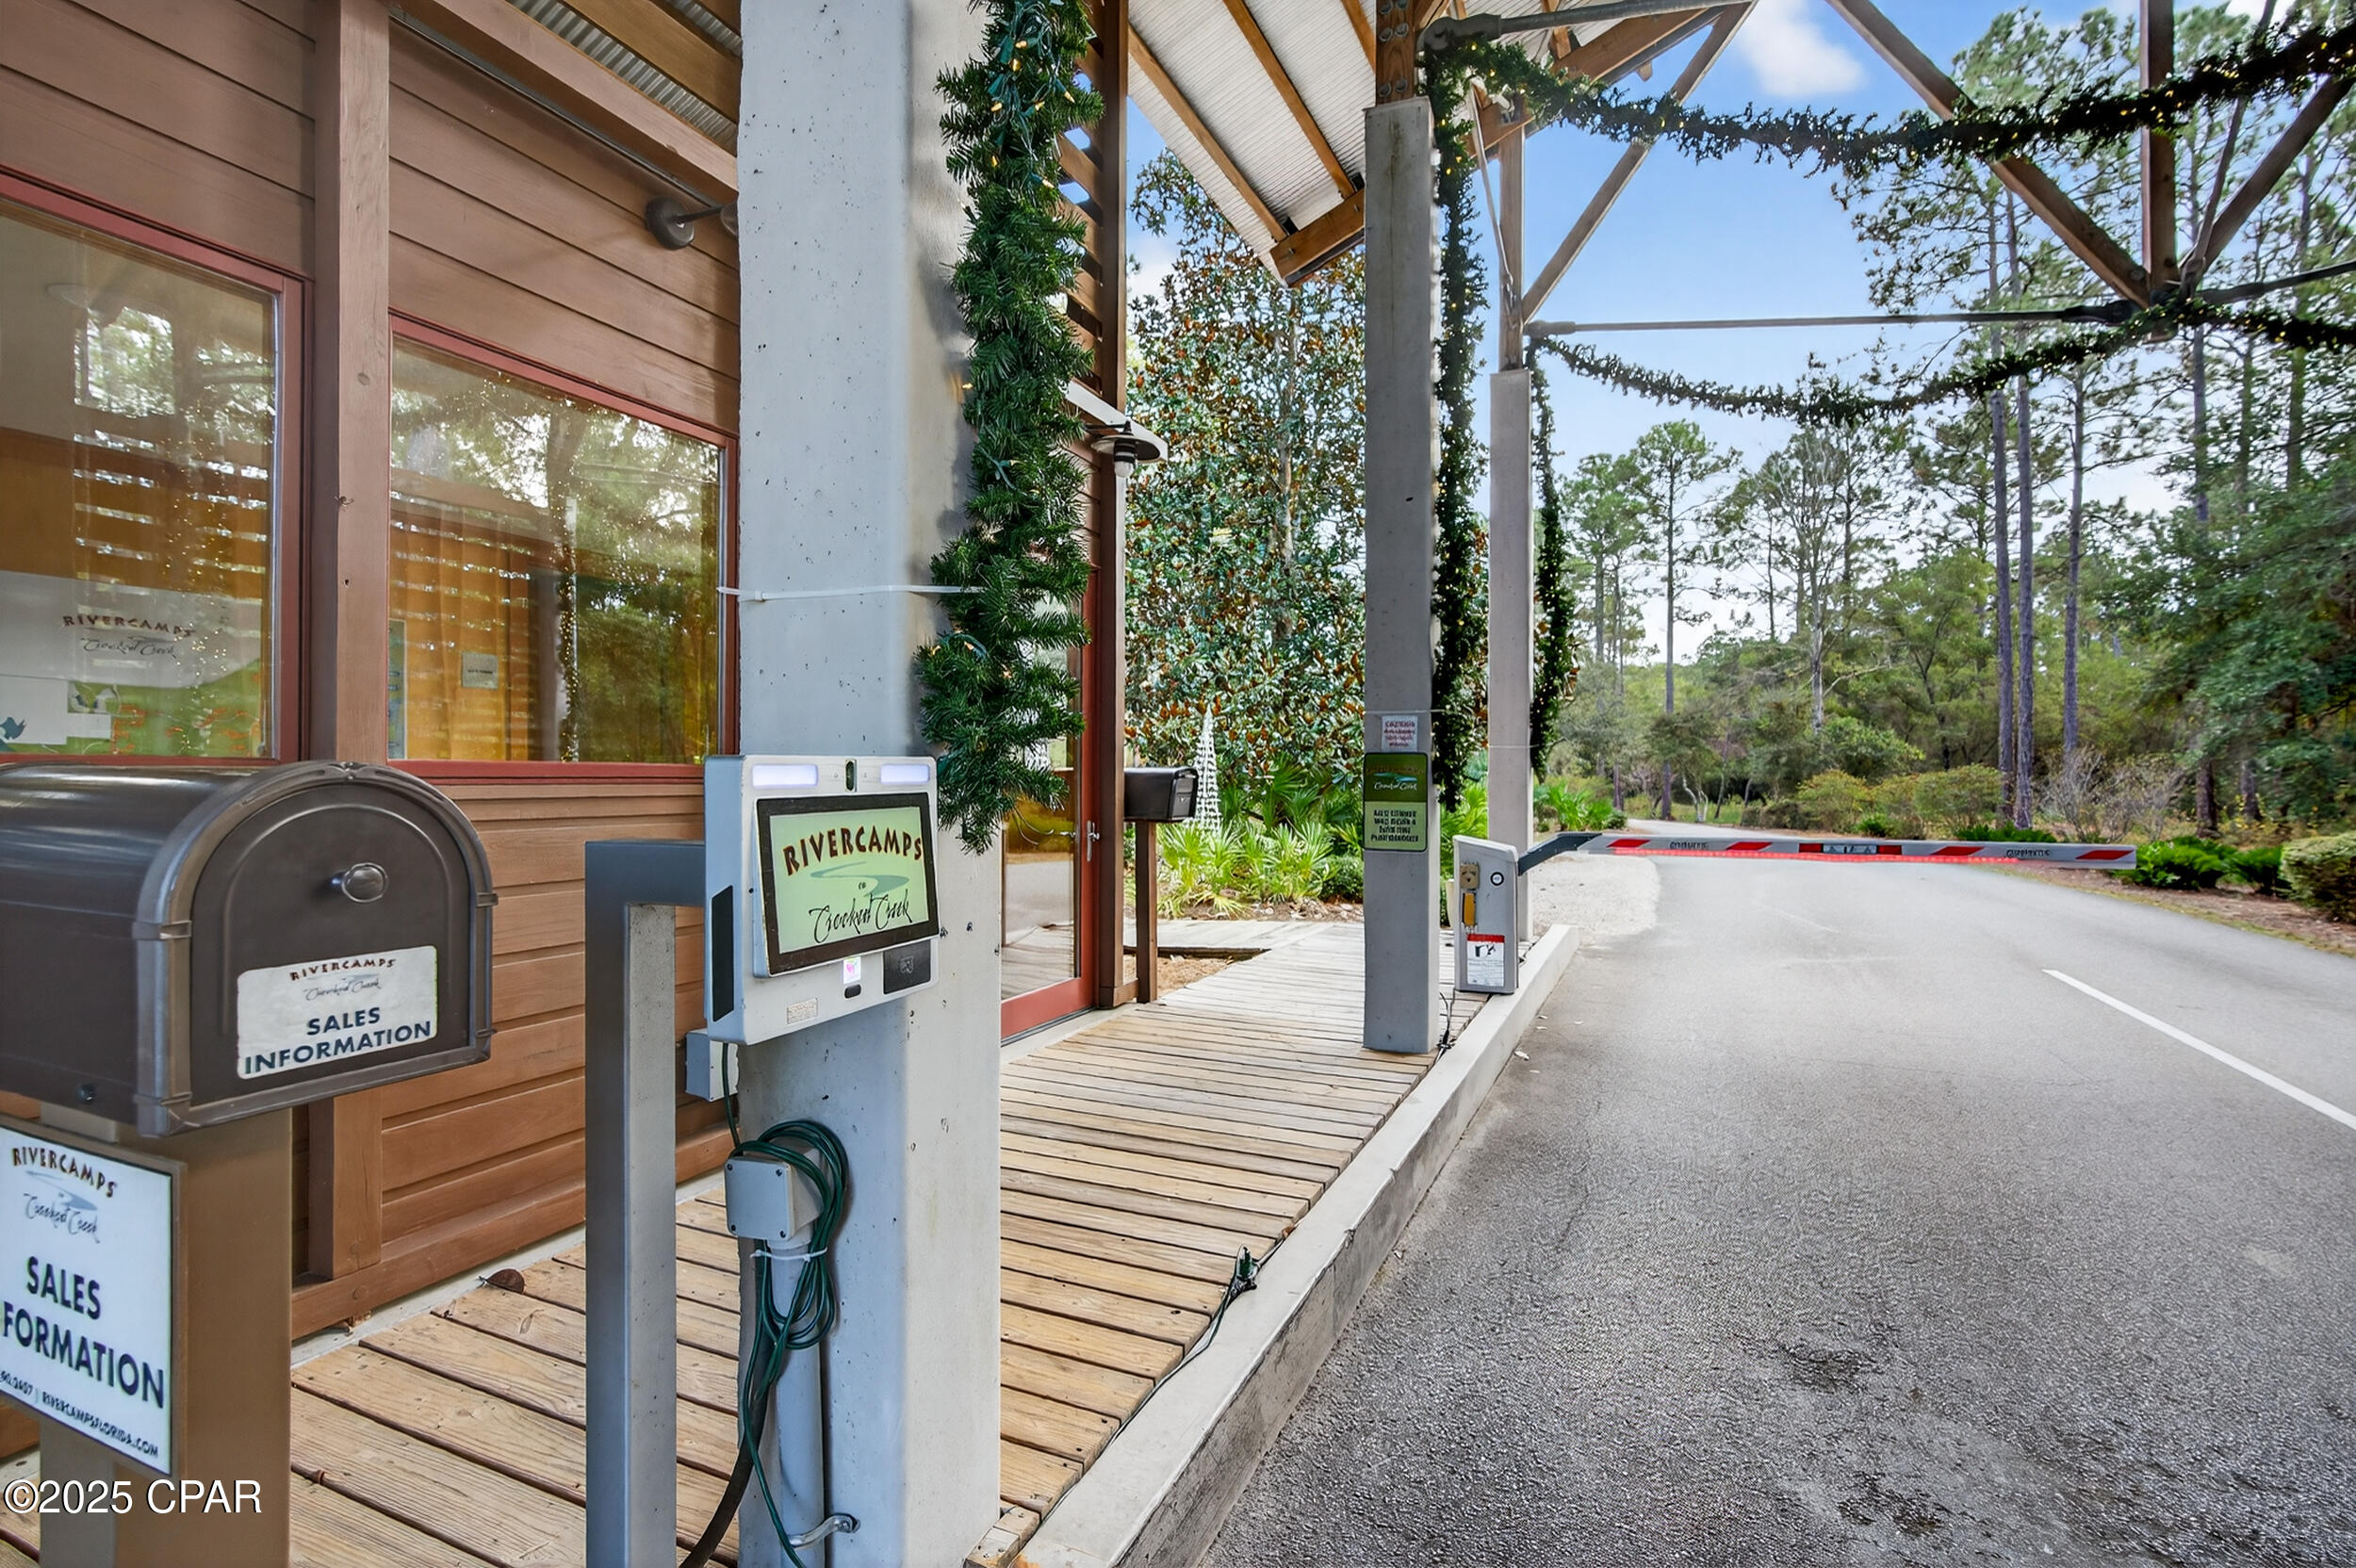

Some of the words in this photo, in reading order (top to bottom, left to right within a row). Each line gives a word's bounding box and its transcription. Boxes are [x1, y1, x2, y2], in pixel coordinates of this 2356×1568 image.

[63, 614, 195, 639] RIVERCAMPS
[782, 825, 923, 876] RIVERCAMPS
[871, 889, 913, 930] Creek
[289, 958, 396, 981] RIVERCAMPS
[306, 1006, 381, 1036] SALES
[244, 1021, 431, 1074] INFORMATION
[12, 1146, 118, 1198] RIVERCAMPS
[26, 1256, 101, 1320] SALES
